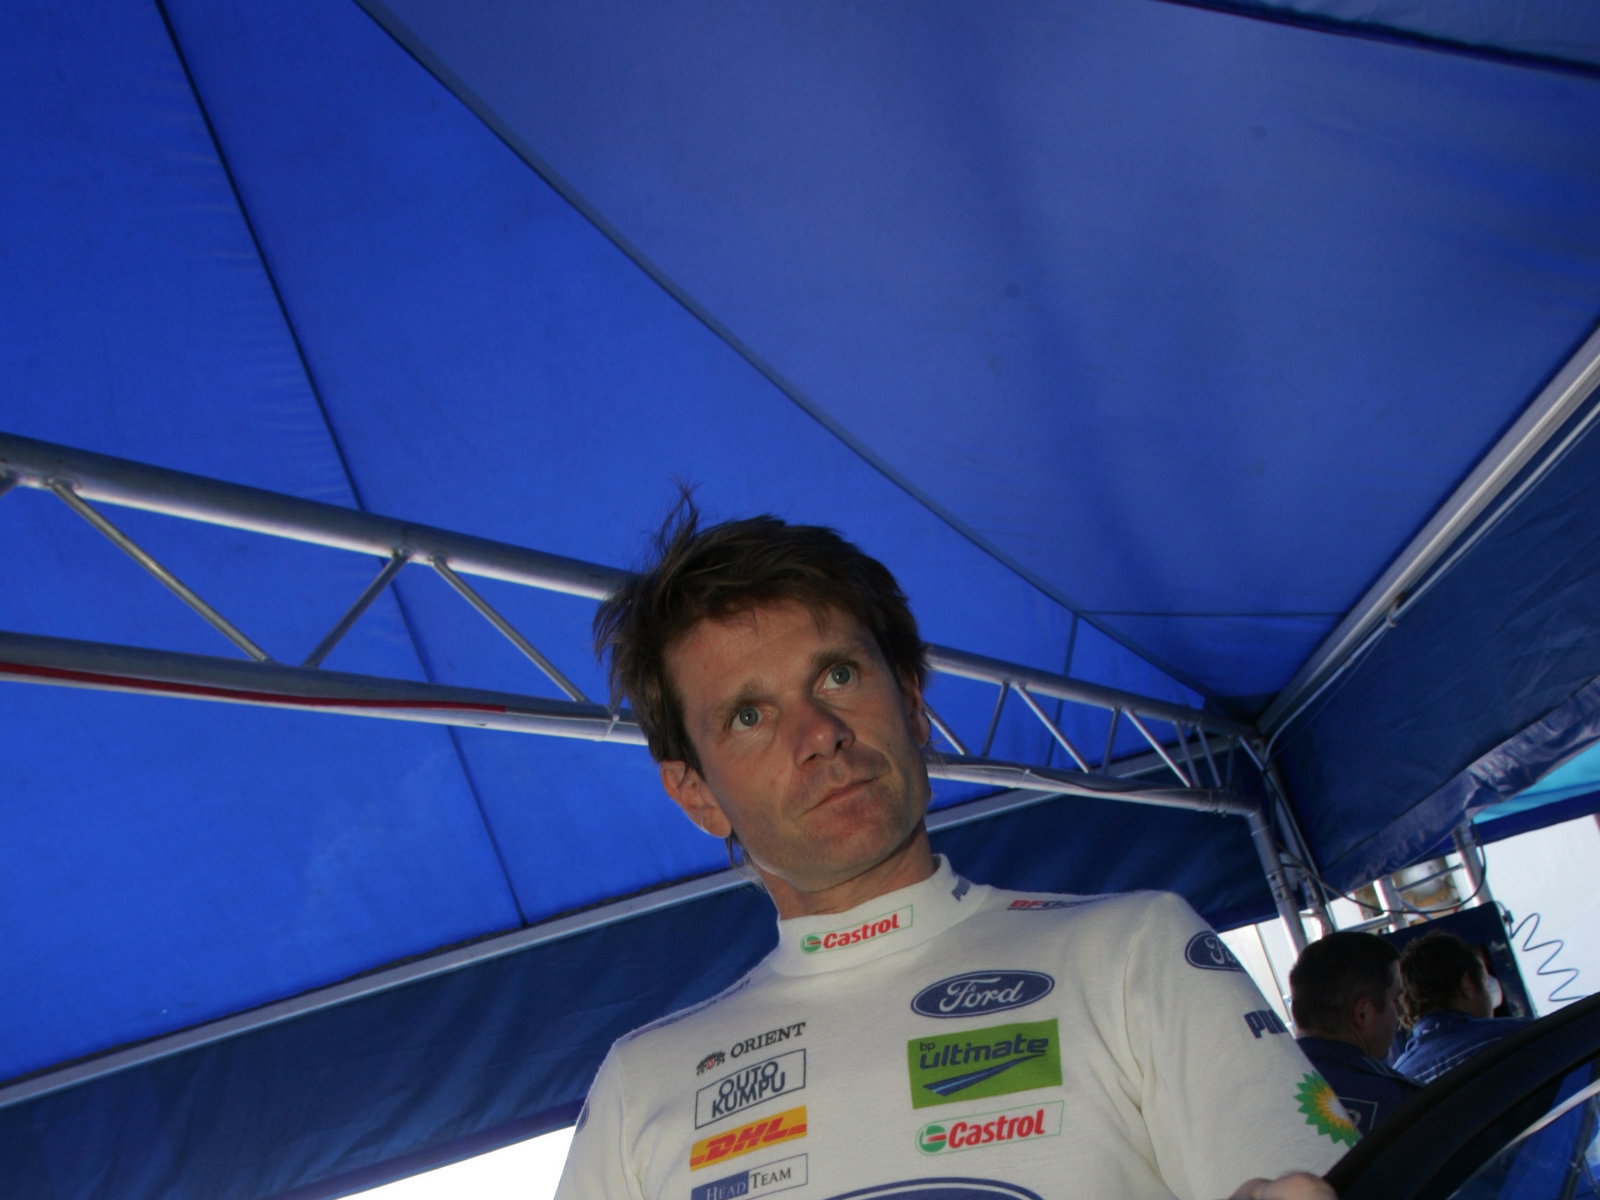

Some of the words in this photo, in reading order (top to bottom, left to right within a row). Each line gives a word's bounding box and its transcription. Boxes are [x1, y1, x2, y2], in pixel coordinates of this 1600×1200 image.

[823, 913, 899, 949] Castrol
[939, 977, 1024, 1012] Ford
[730, 1022, 806, 1058] ORIENT
[919, 1041, 937, 1053] bp
[919, 1033, 1050, 1070] ultimate
[711, 1071, 786, 1119] KUMPU
[718, 1060, 779, 1098] OUTO
[704, 1116, 789, 1162] DHL
[948, 1108, 1046, 1149] Castrol
